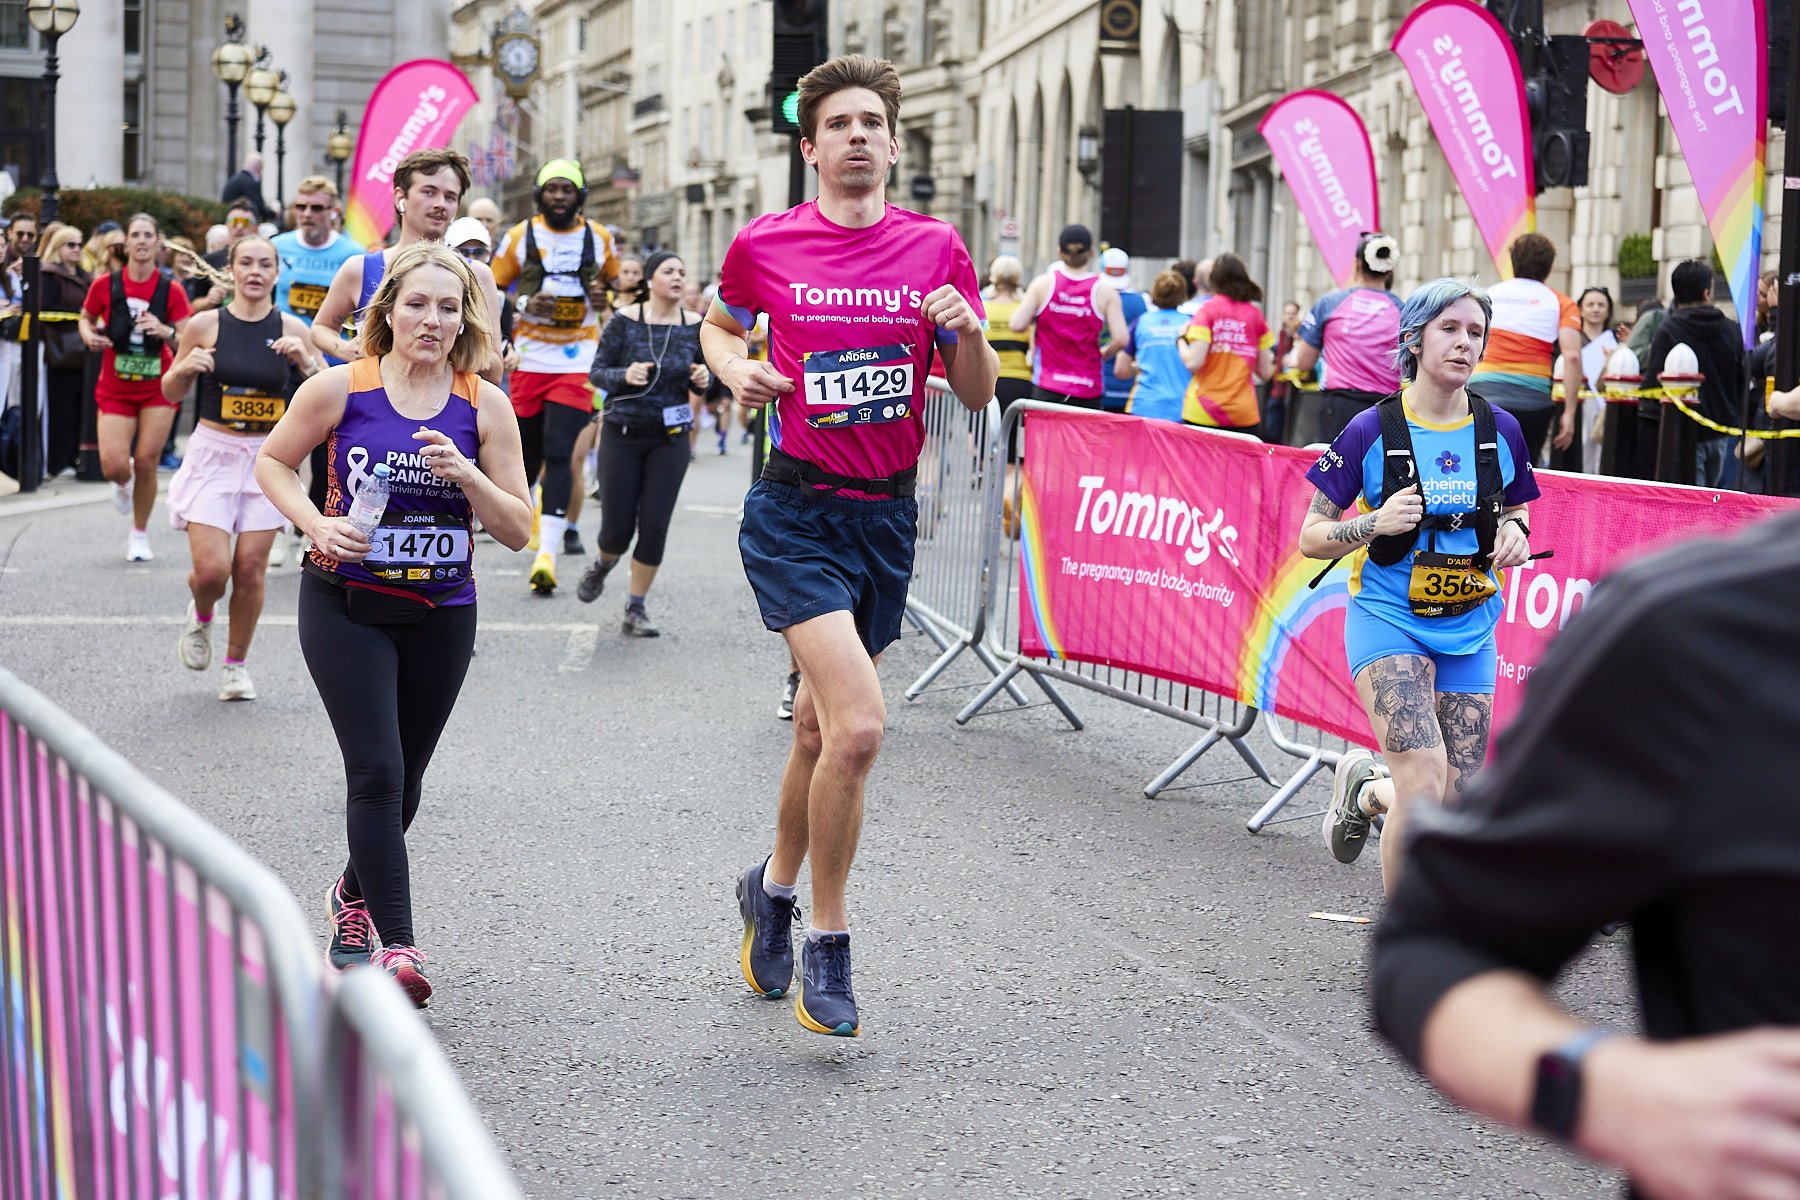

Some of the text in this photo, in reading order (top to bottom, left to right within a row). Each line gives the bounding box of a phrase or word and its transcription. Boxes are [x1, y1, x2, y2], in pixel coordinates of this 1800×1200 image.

[365, 84, 446, 184] Tommy's
[789, 283, 922, 313] Tommy's
[790, 314, 919, 326] The pregnancy and baby charity
[838, 351, 880, 363] ANDREA
[814, 368, 907, 401] 11429
[232, 400, 275, 417] 3834
[386, 450, 448, 470] PANC
[426, 488, 440, 497] for
[1423, 490, 1476, 508] Society
[402, 515, 435, 523] JOANNE
[1075, 475, 1240, 567] Tommy's
[383, 533, 454, 558] 1470
[1447, 557, 1472, 566] D'ARC
[1062, 557, 1235, 608] The pregnancy and baby charity
